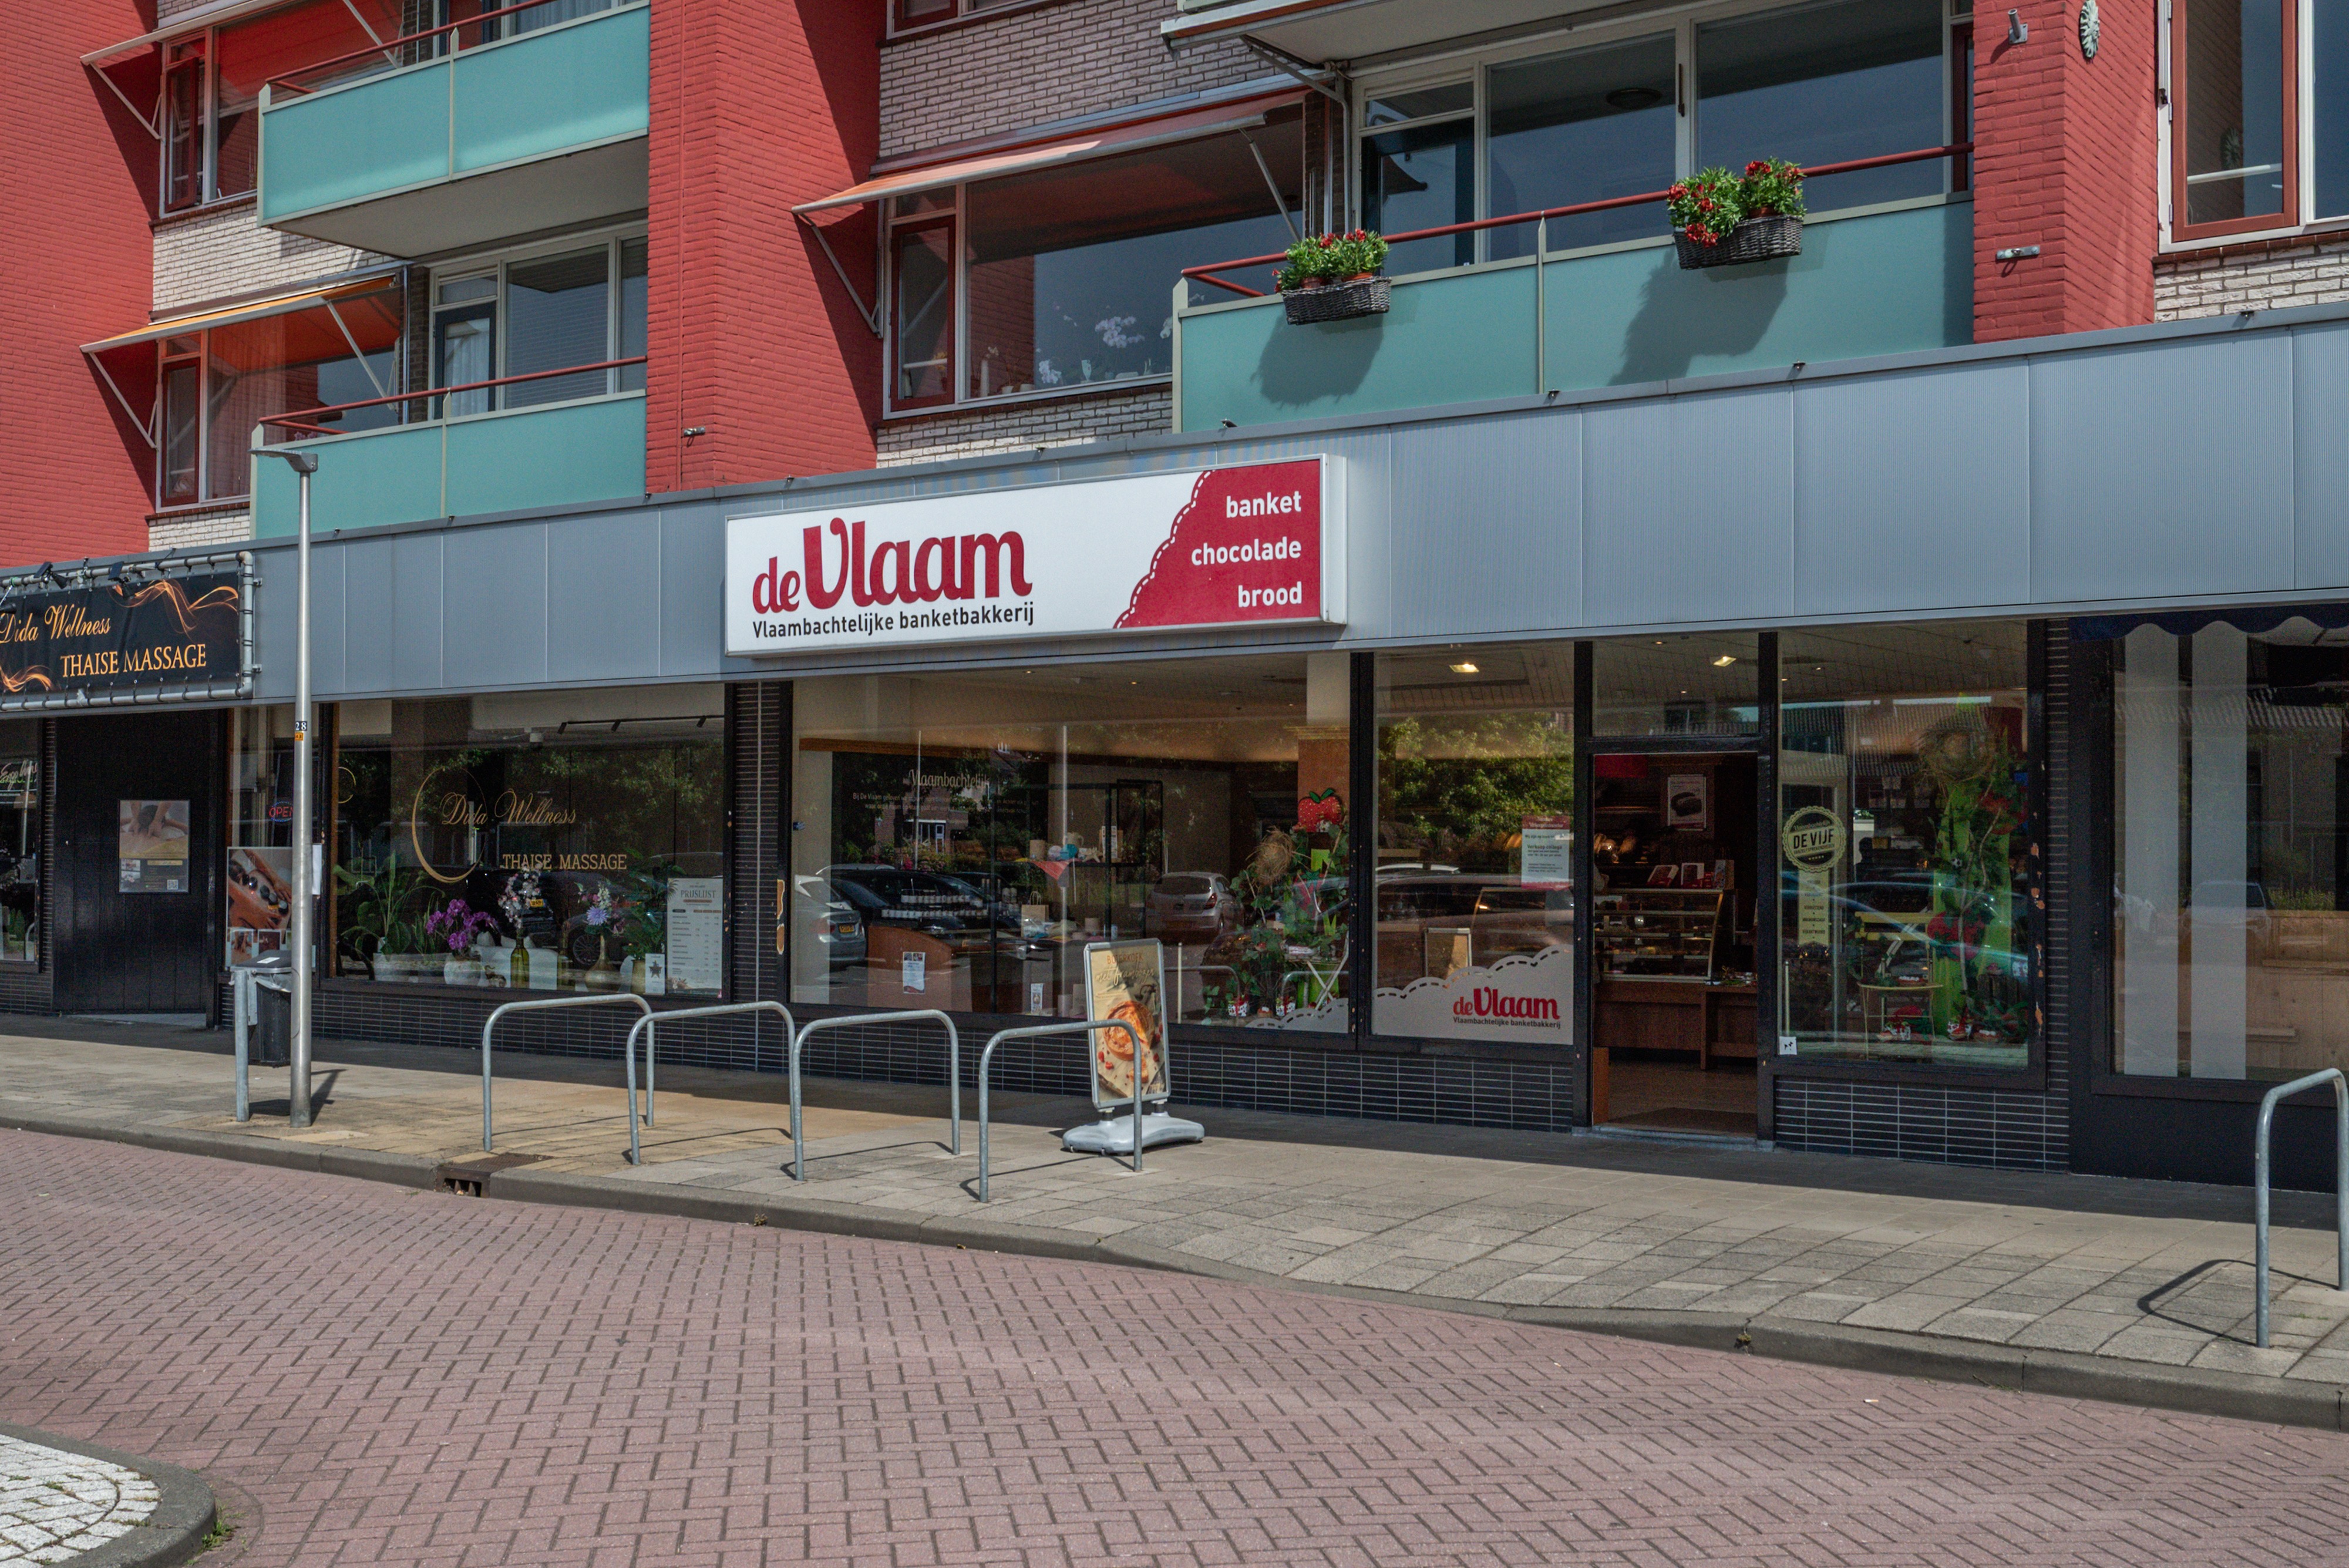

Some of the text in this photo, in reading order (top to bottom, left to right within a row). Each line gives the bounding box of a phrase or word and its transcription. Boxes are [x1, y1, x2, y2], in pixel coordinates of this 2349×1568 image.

[1226, 491, 1301, 518] banket
[753, 517, 1033, 614] de Vlaam
[1192, 537, 1301, 566] chocolade
[1238, 582, 1302, 608] brood
[0, 604, 111, 644] Dida Wellness
[753, 602, 1034, 638] Vlaambachtelijke banketbakkerij
[60, 644, 207, 677] THAISE MASSAGE
[295, 722, 307, 731] 28
[440, 788, 576, 825] Dida Wellness
[1793, 829, 1834, 849] DE VIJF
[503, 853, 627, 870] THAISE MASSAGE
[681, 889, 716, 899] PRIJSLIJST
[1453, 987, 1561, 1019] de Vlaam
[1453, 1017, 1561, 1029] Vlaambachtelijke banketbakkerij
